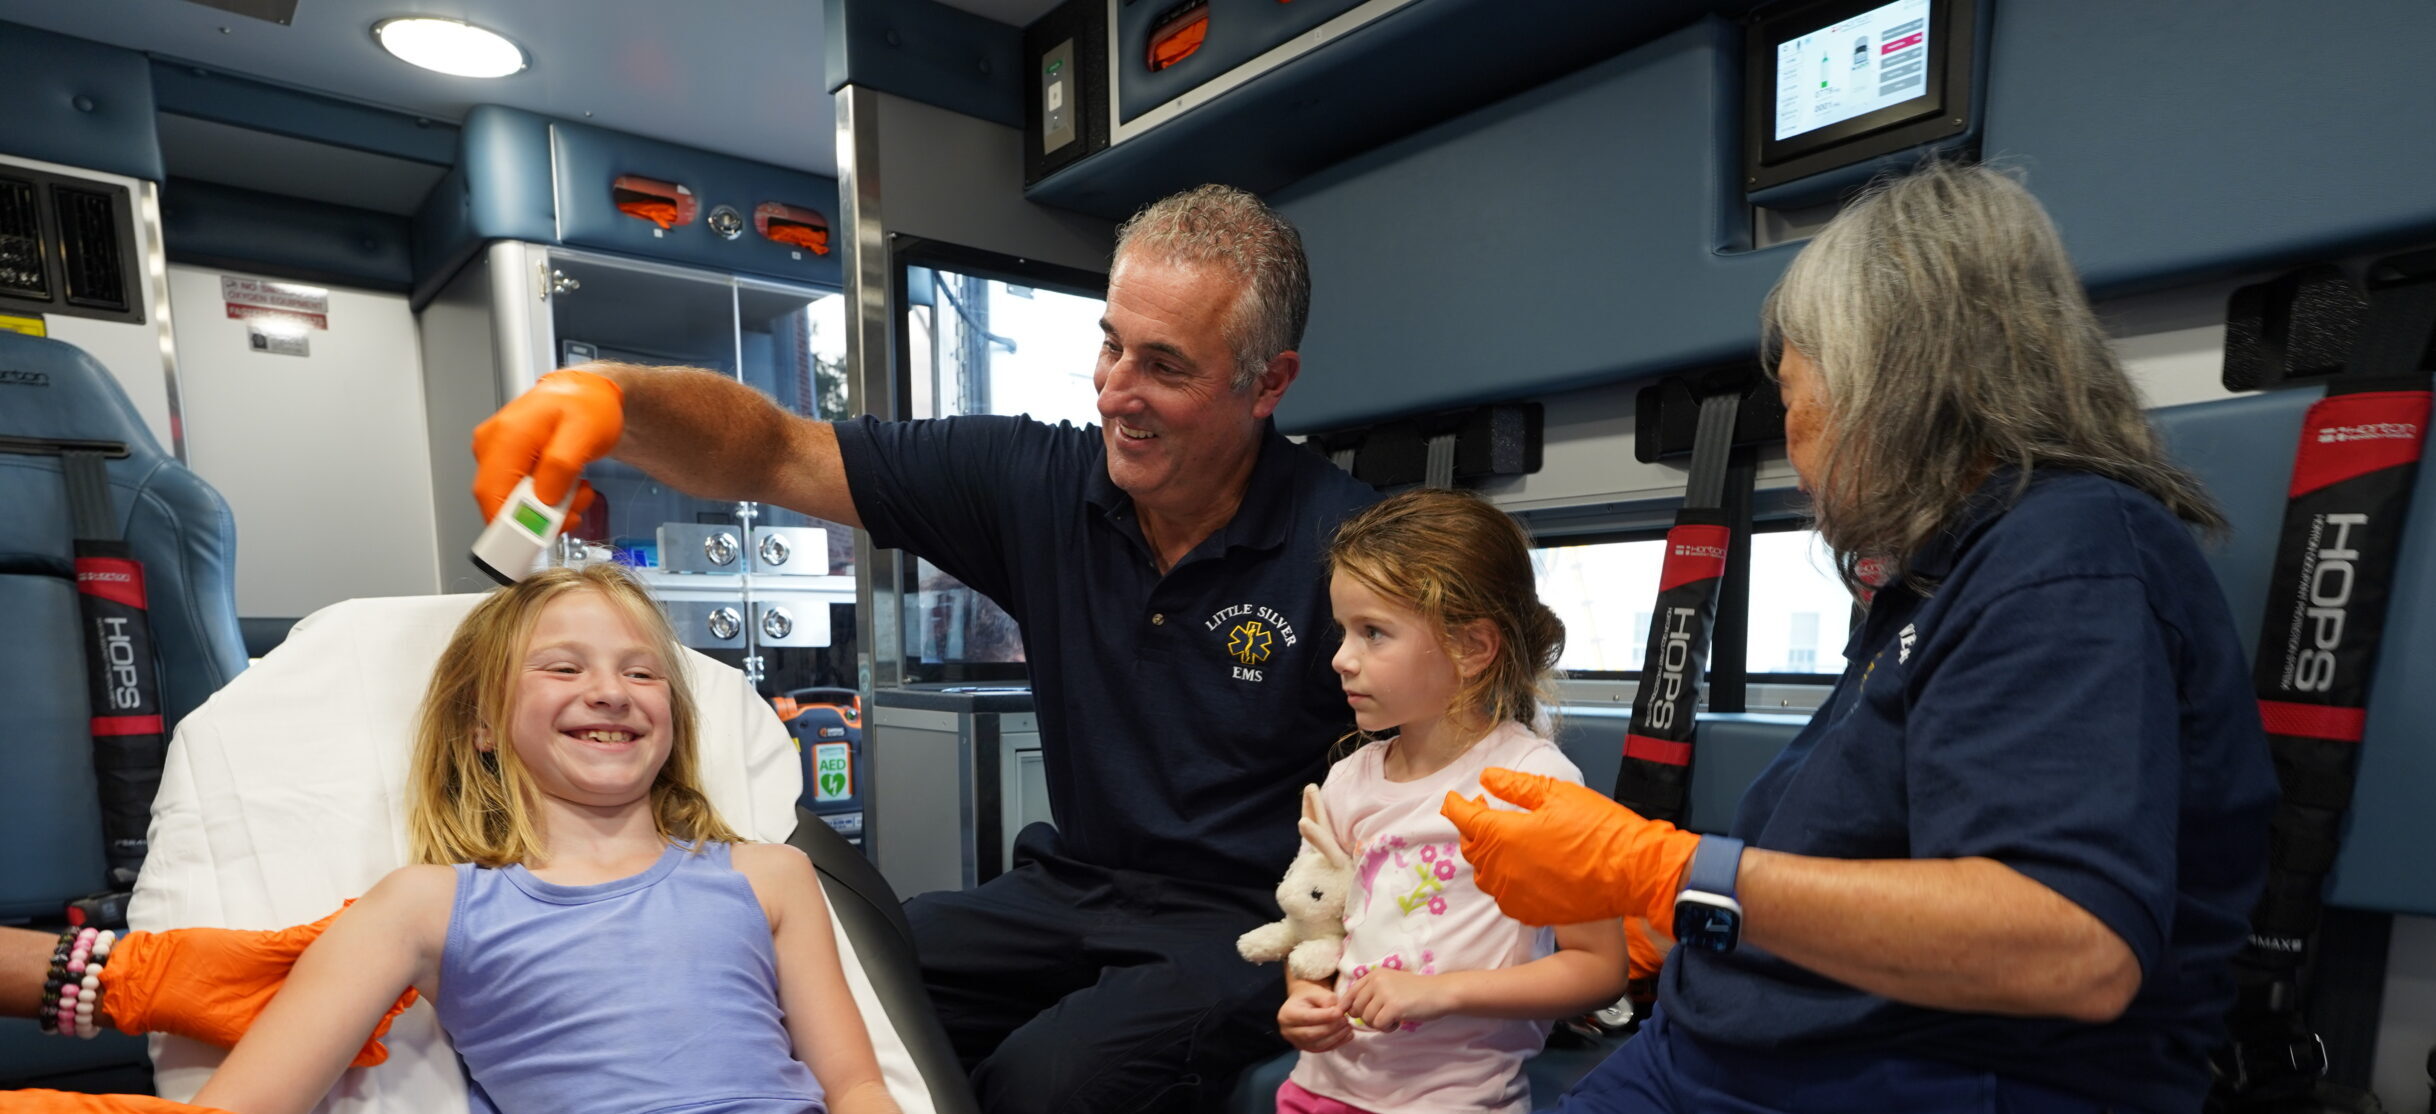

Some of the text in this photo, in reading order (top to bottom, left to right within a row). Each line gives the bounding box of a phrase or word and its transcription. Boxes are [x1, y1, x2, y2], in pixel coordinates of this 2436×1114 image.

[1205, 604, 1297, 647] LITTLE SILVER
[2295, 513, 2369, 691] HOPS
[104, 617, 141, 709] HOPS
[1231, 666, 1263, 682] EMS
[1652, 607, 1696, 730] HOPS
[820, 759, 846, 771] AED
